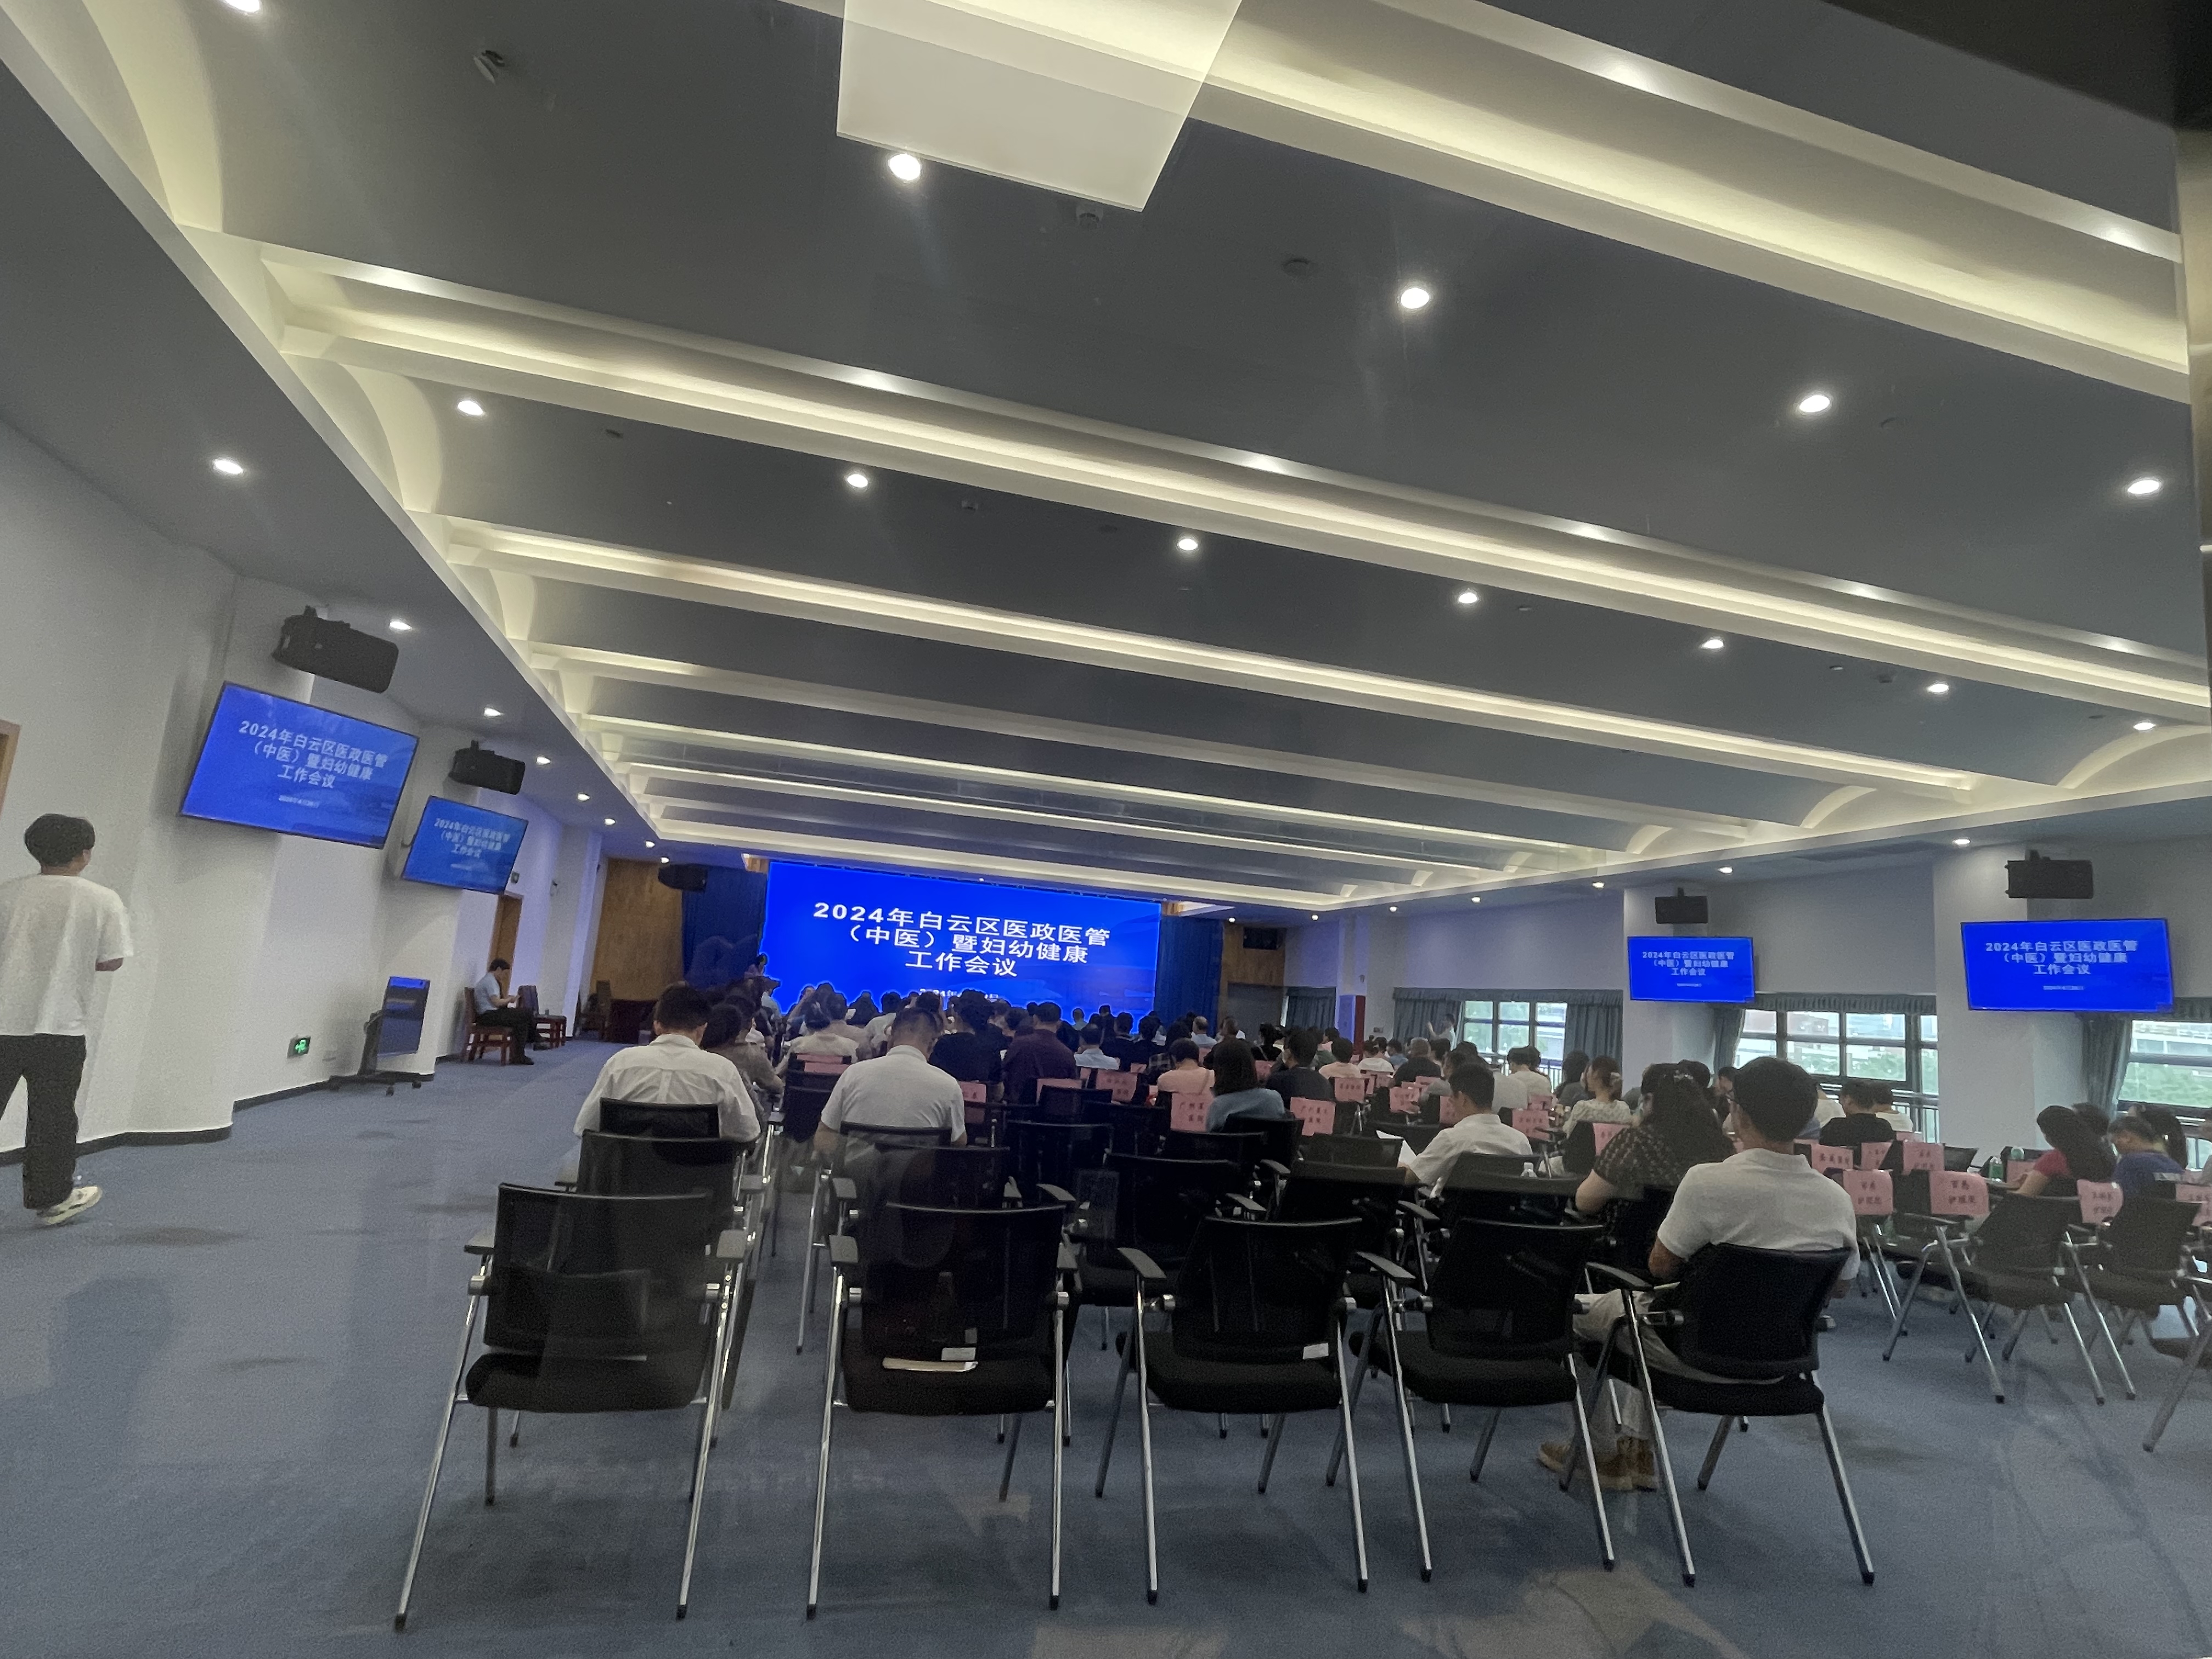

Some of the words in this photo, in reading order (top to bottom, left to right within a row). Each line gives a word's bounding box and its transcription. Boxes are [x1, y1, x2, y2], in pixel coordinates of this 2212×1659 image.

[277, 764, 336, 788] 工作会议
[813, 902, 1110, 947] 2024年白云区医政医管
[850, 924, 1088, 964] （中医）暨妇幼健康
[905, 951, 1017, 977] 工作会议
[2033, 964, 2091, 974] 工作会议
